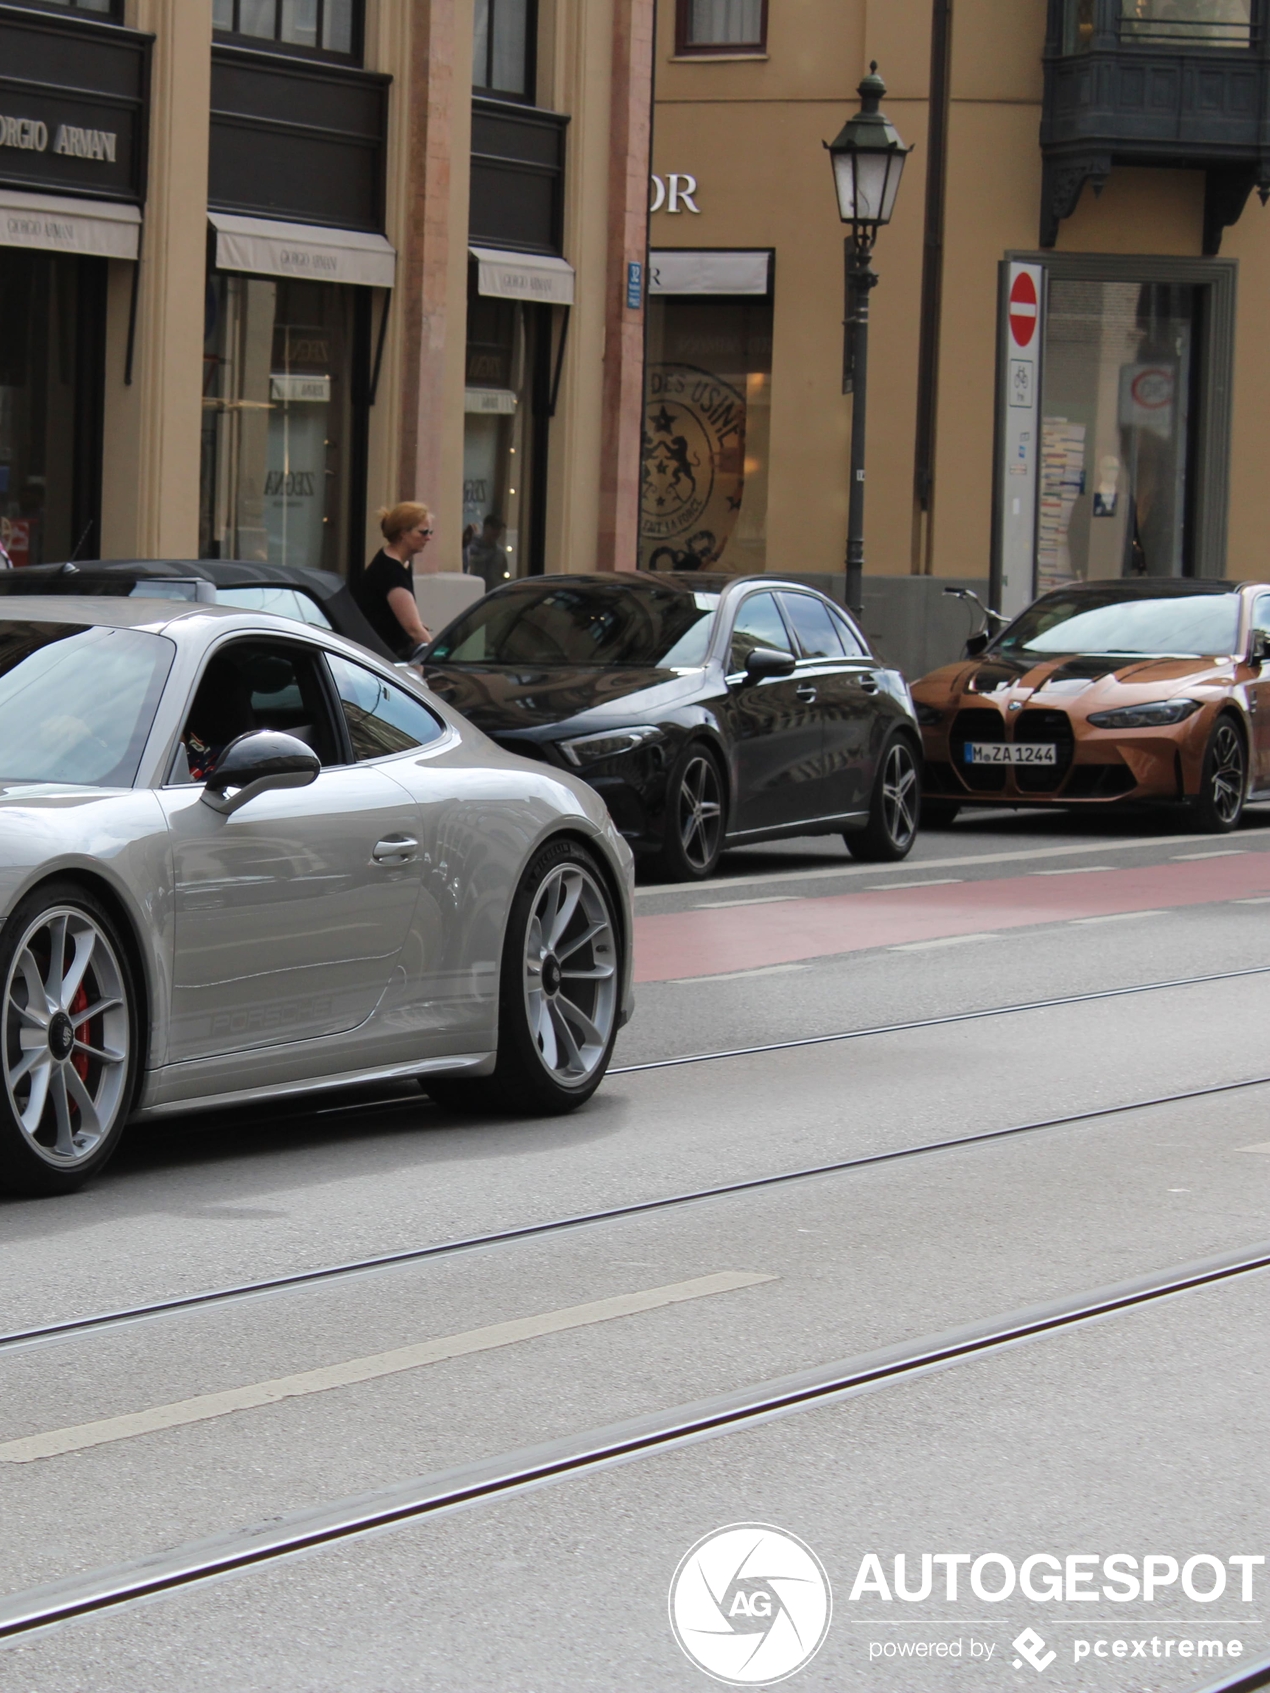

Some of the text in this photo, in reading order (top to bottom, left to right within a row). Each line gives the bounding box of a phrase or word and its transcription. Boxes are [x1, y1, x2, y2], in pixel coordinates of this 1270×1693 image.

[53, 124, 117, 162] ARMANI
[973, 746, 1053, 762] M ZA 1244
